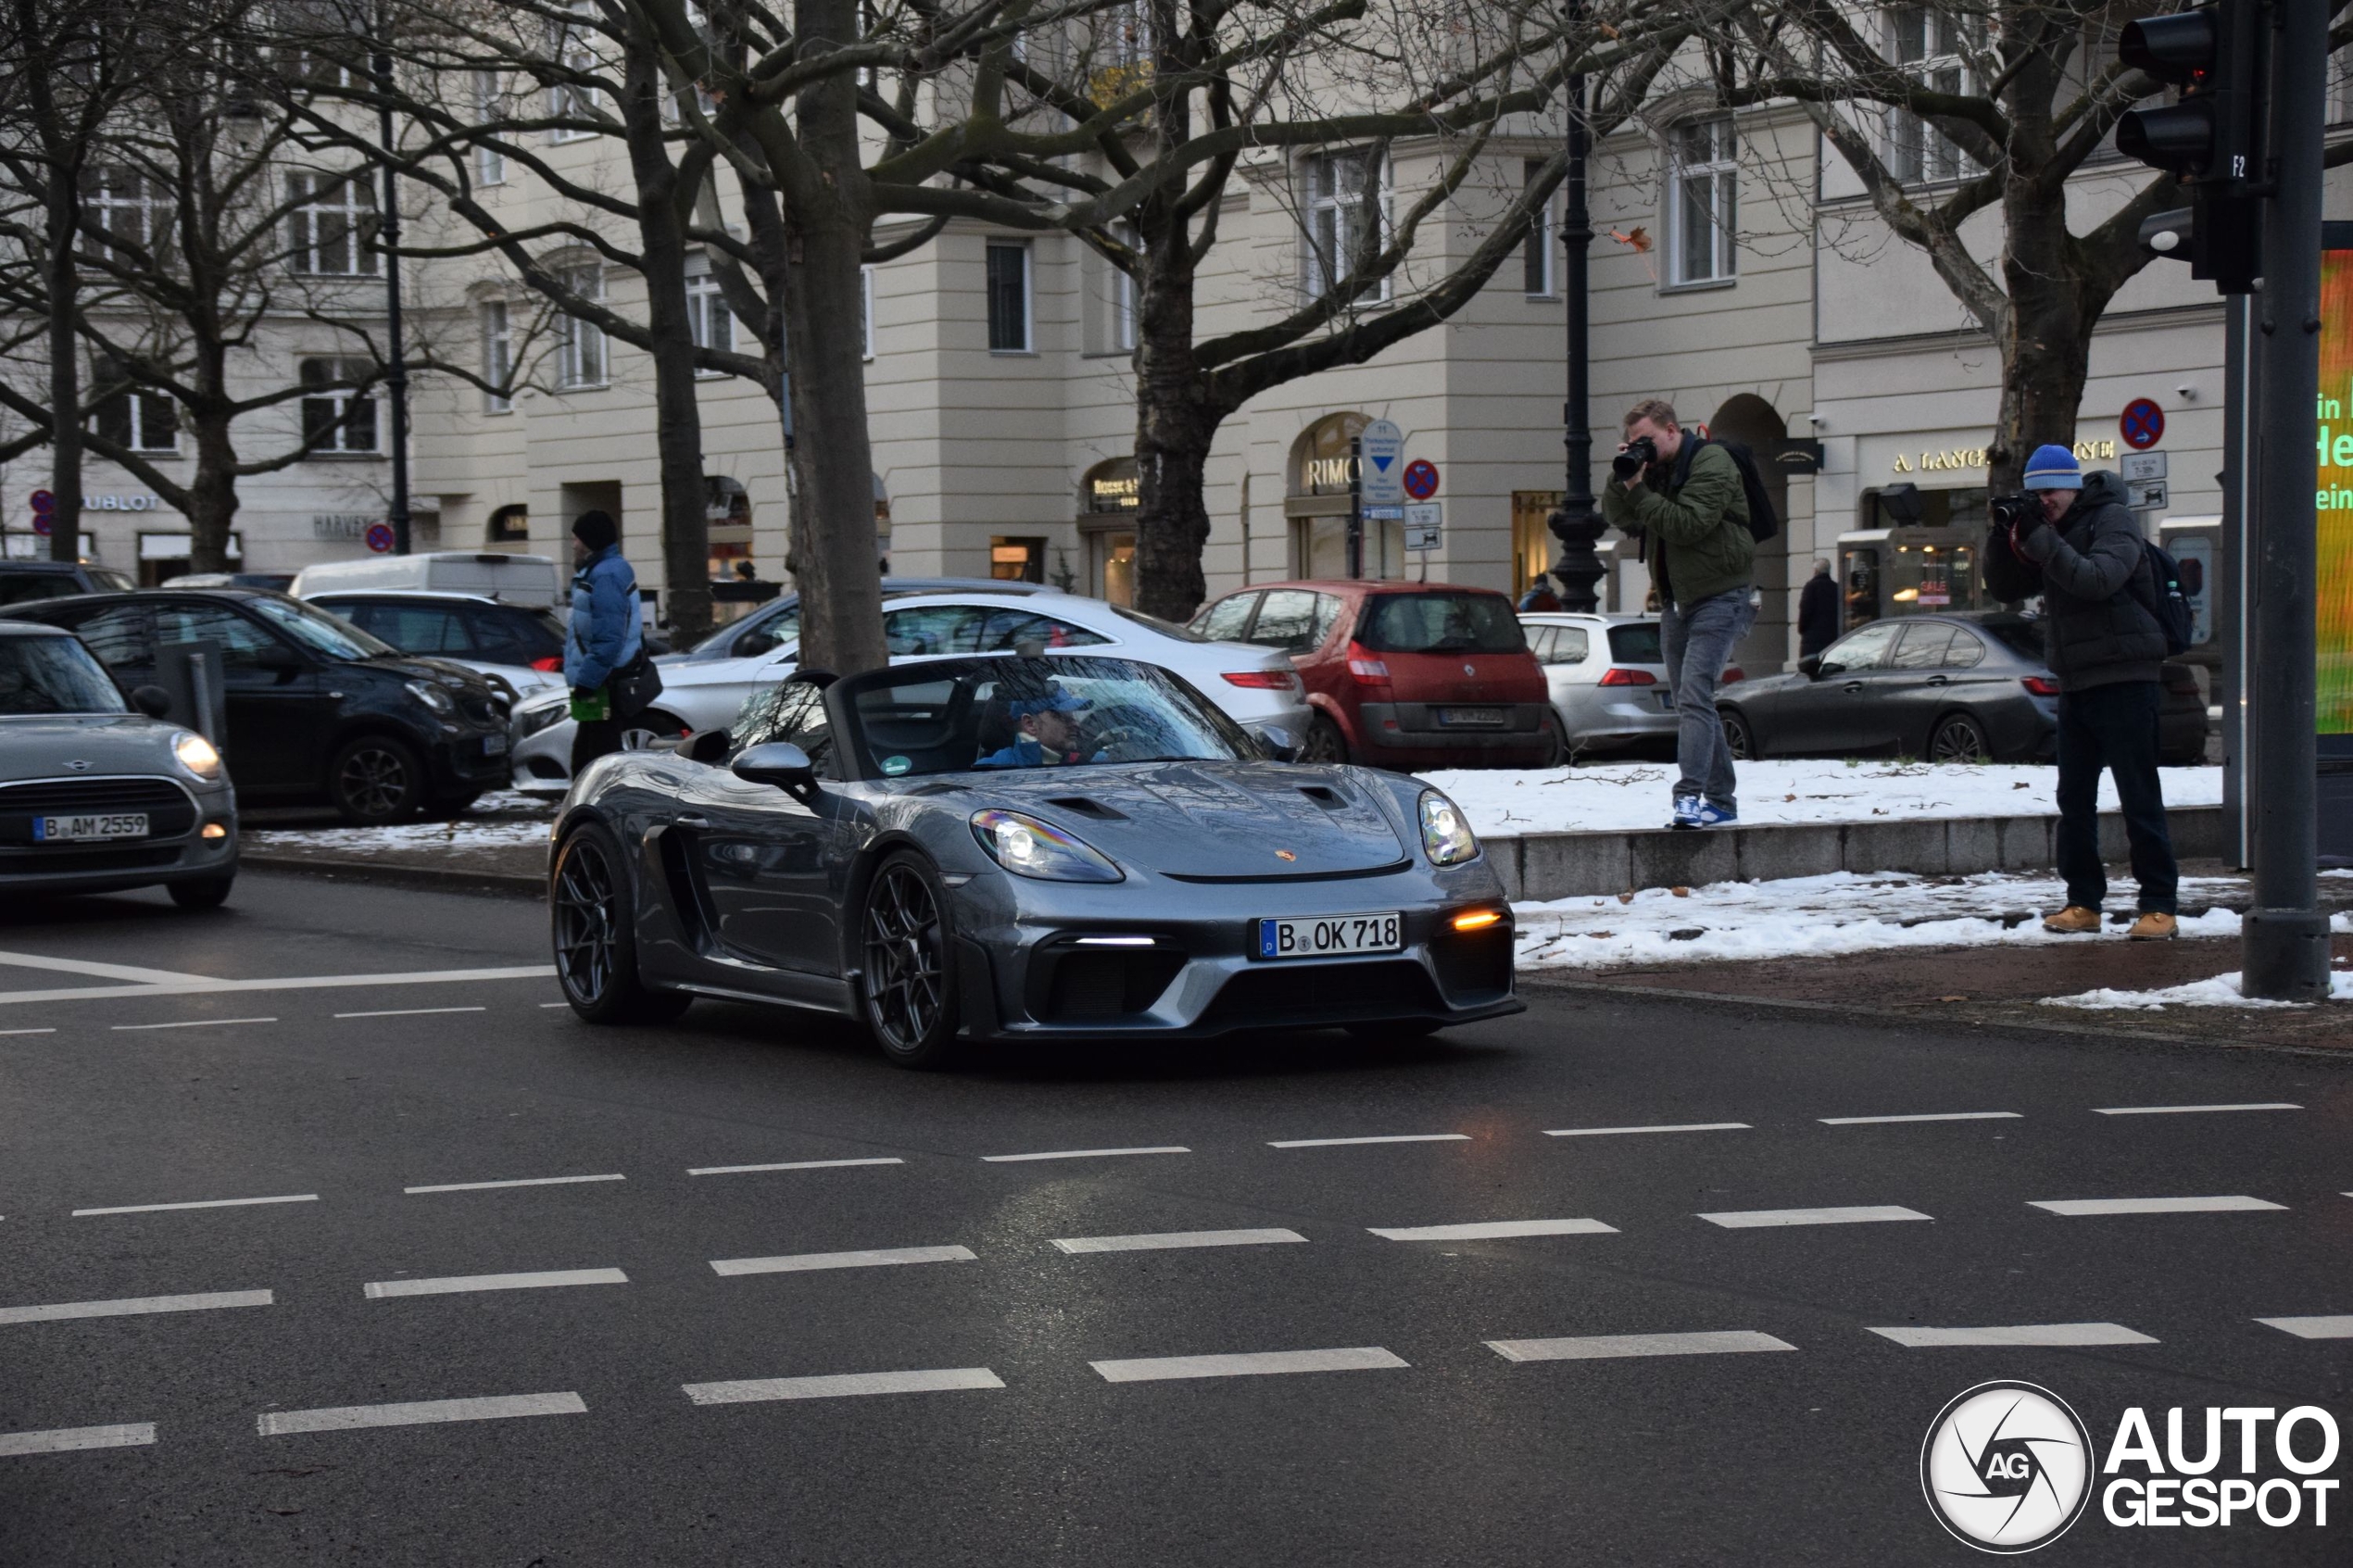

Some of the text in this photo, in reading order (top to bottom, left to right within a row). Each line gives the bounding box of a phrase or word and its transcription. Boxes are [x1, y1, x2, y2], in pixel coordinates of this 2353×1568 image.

[2233, 156, 2246, 177] F2
[1308, 458, 1363, 485] RIMO
[84, 495, 159, 510] UBLOT
[1920, 581, 1946, 592] SALE
[45, 816, 145, 836] B AM 2559
[1278, 924, 1295, 951] B
[1315, 921, 1347, 949] OK
[1353, 918, 1397, 947] 718
